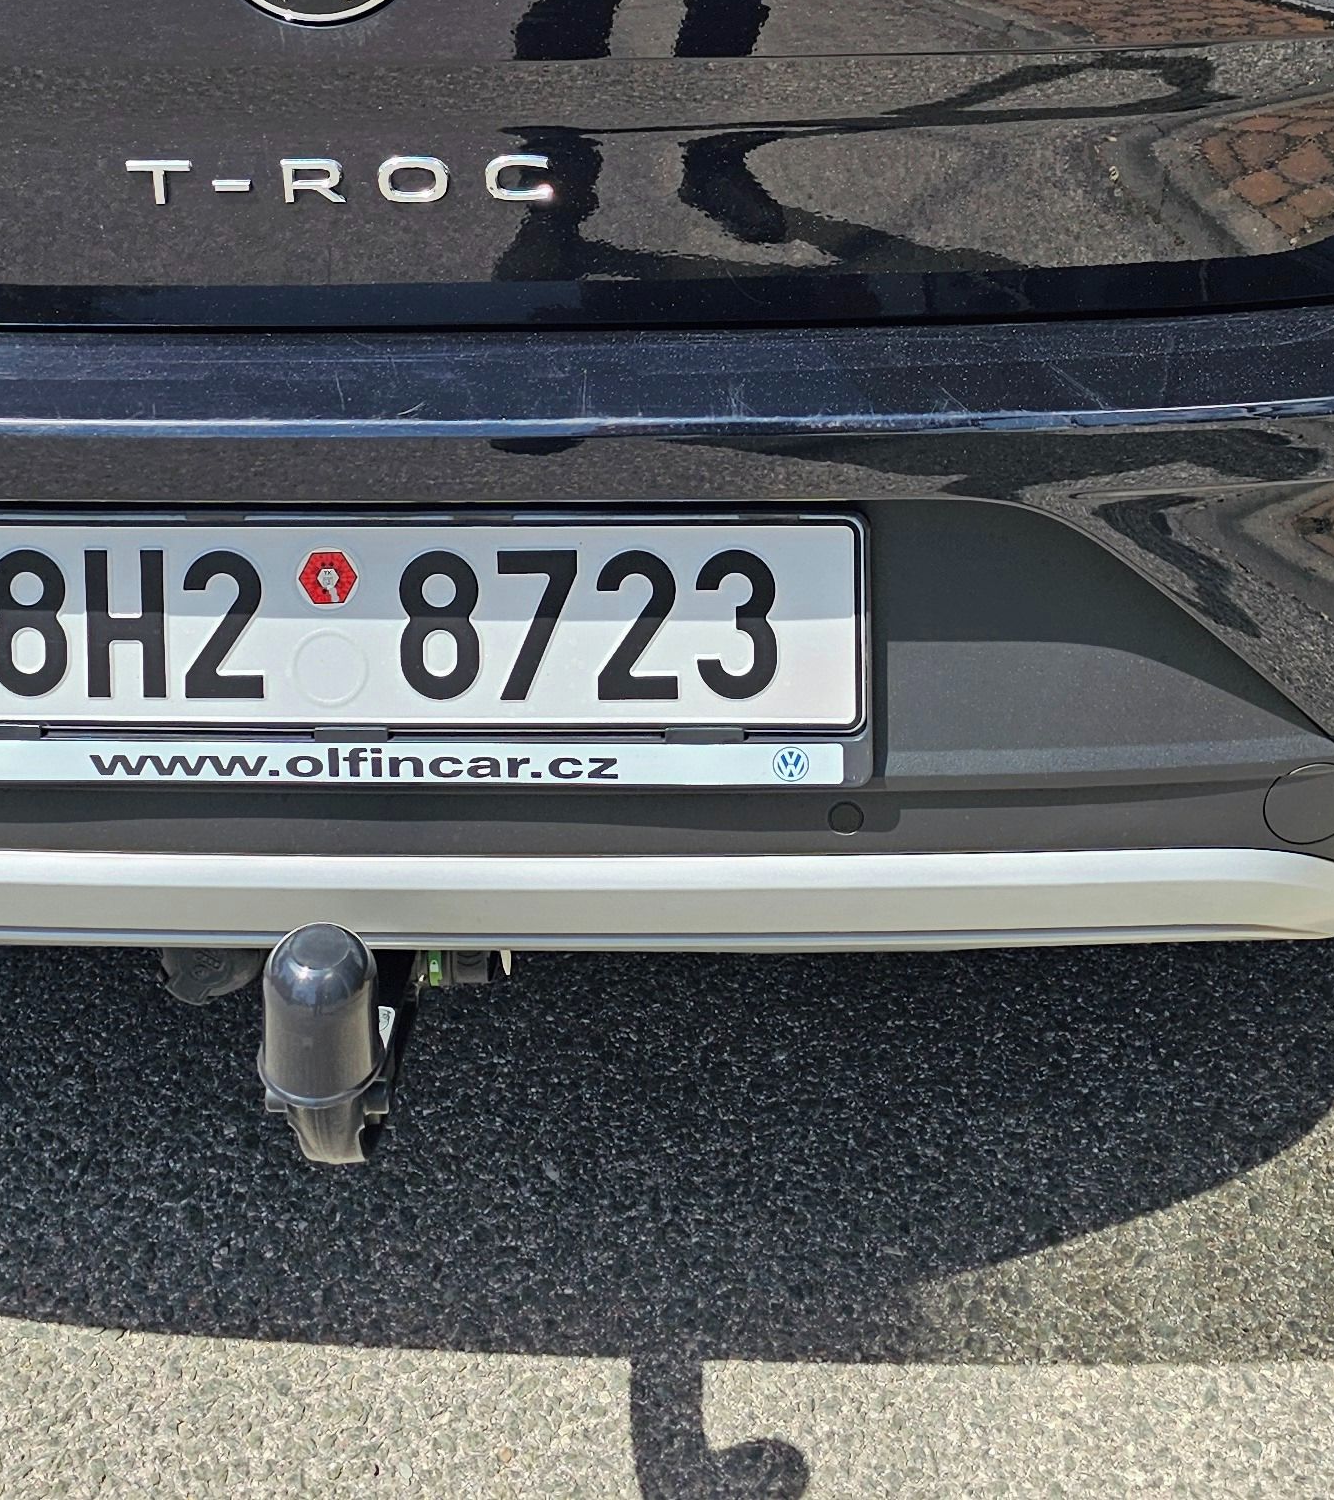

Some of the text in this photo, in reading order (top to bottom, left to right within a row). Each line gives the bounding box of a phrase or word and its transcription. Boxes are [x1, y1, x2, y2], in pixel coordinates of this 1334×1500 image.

[124, 154, 555, 206] T-ROC
[398, 549, 778, 701] 8723
[88, 746, 620, 780] www.olfincar.cz
